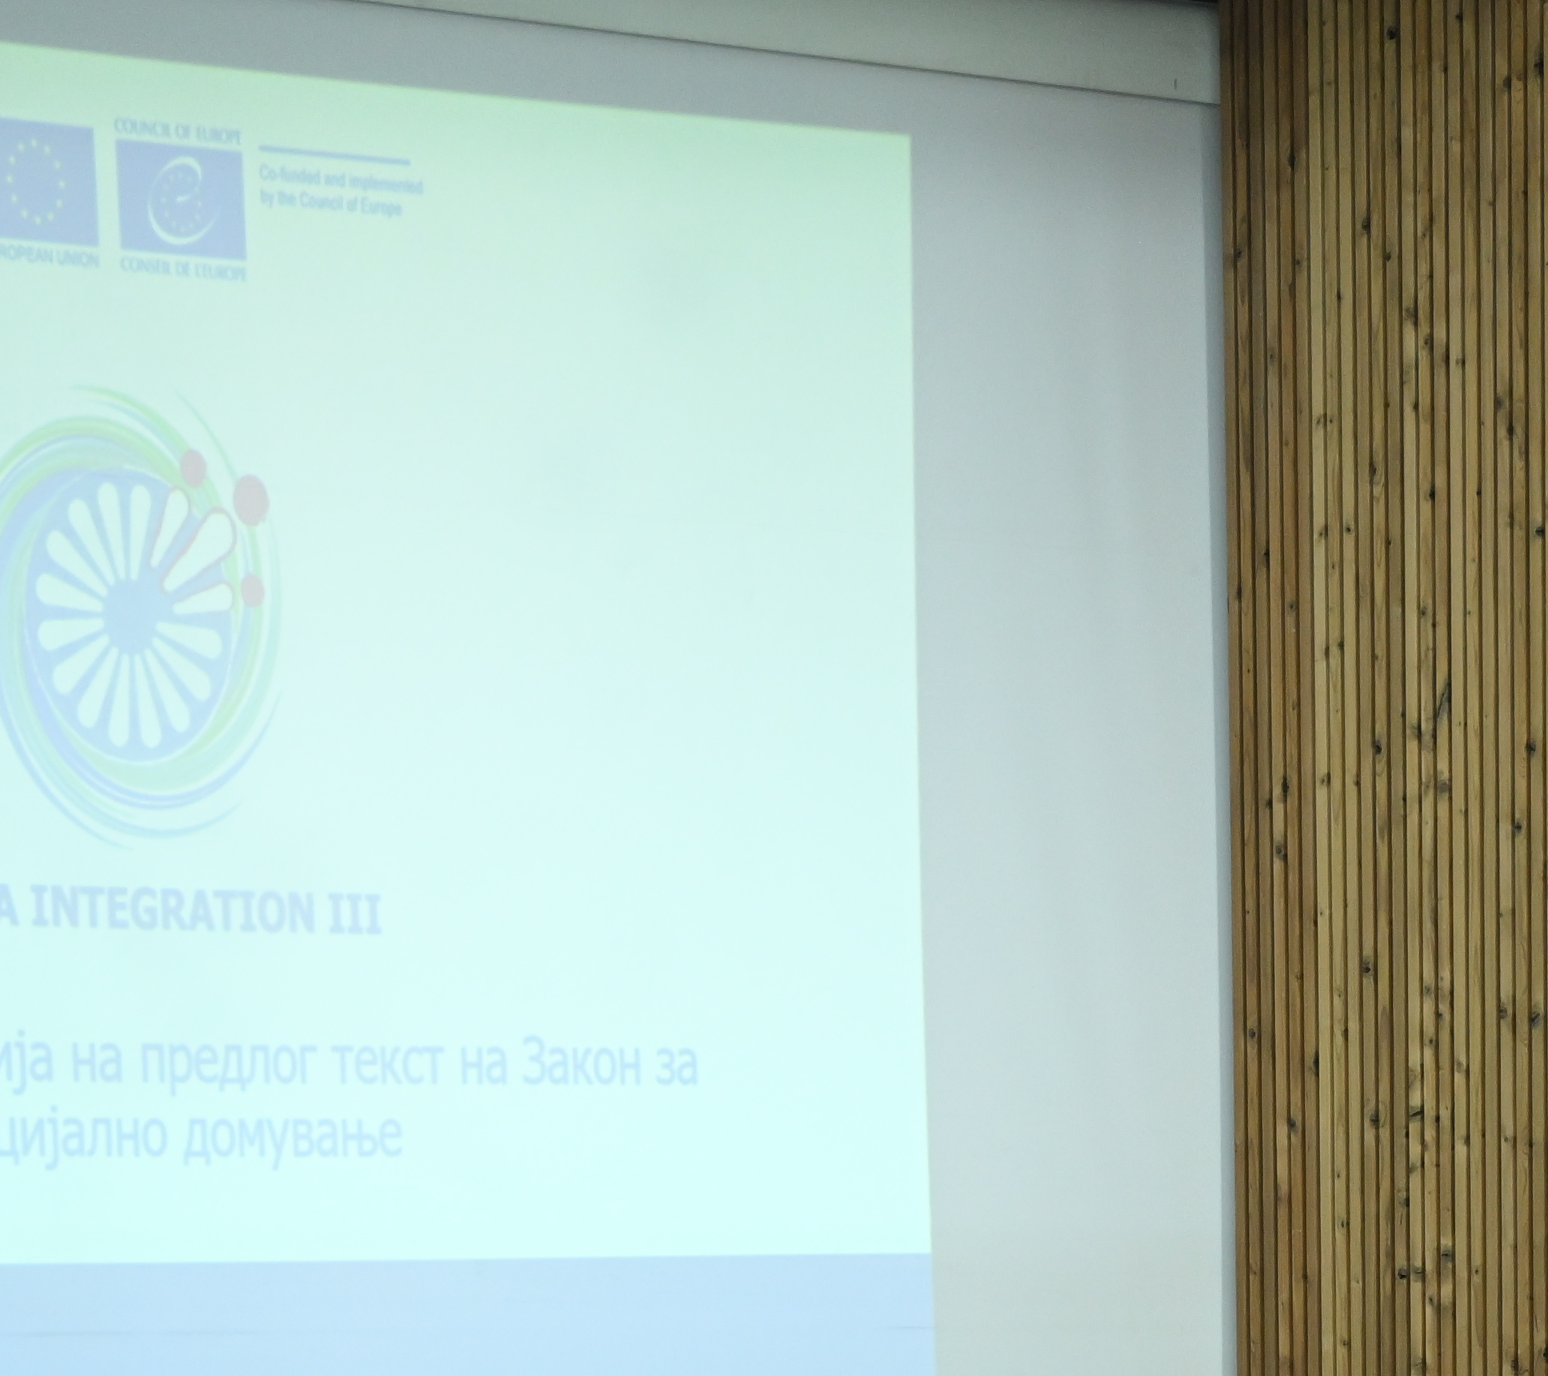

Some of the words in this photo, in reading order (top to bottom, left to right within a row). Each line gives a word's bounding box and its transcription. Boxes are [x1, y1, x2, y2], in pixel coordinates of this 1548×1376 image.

[113, 117, 171, 138] COUNCIL
[174, 122, 191, 140] OF
[195, 124, 242, 145] EUROPE
[258, 163, 321, 186] Co-funded
[324, 169, 346, 188] and
[348, 171, 424, 195] implemented
[259, 188, 275, 208] by
[277, 190, 297, 208] the
[299, 191, 343, 211] Council
[346, 195, 358, 212] of
[361, 195, 403, 218] Europe
[54, 250, 100, 269] UNION
[119, 256, 172, 276] CONSEIL
[175, 261, 190, 278] DE
[30, 883, 316, 935] INTEGRATION
[328, 892, 384, 936] III
[70, 1040, 124, 1083] на
[140, 1043, 318, 1098] предлог
[330, 1044, 446, 1087] текст
[459, 1044, 508, 1087] на
[520, 1033, 642, 1087] Закон
[654, 1044, 699, 1087] за
[182, 1115, 404, 1172] домување
